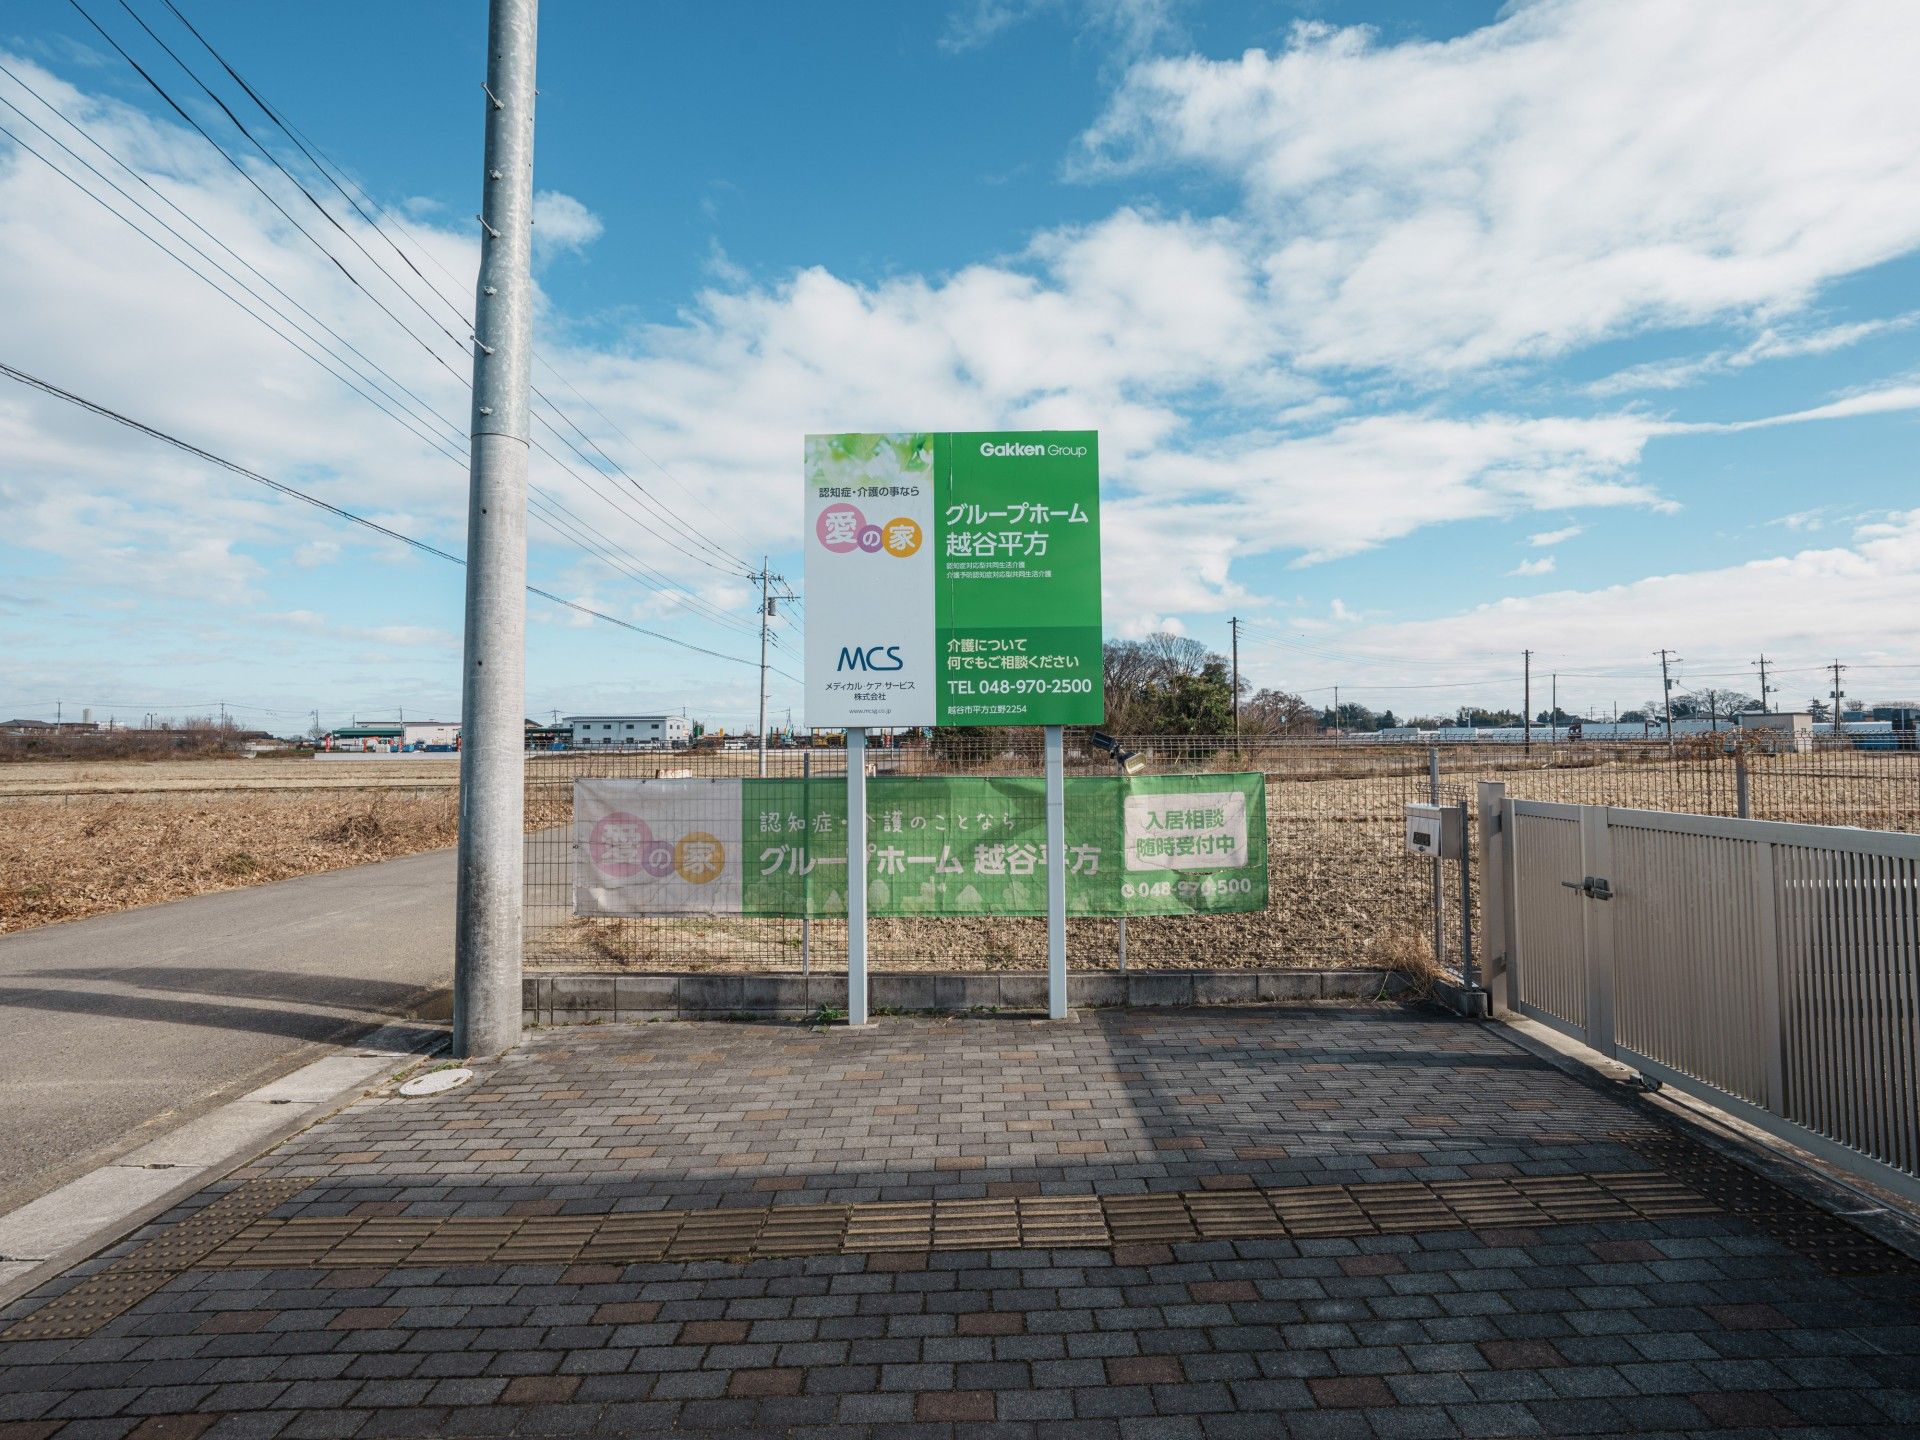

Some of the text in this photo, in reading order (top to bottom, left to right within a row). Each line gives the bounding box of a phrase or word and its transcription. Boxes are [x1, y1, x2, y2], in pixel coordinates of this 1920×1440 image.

[980, 442, 1088, 457] Gakken Group
[818, 486, 920, 498] 認知症・介護の事なら
[945, 501, 1089, 526] グループホーム
[825, 511, 916, 551] 愛の家
[946, 531, 1049, 557] 越谷平方
[947, 638, 1028, 653] 介護について
[836, 646, 904, 672] MCS
[947, 655, 1080, 671] 何でもご相談ください
[853, 692, 887, 701] 株式会社
[947, 679, 1092, 695] TEL 048-970-2500
[947, 704, 1028, 715] 越谷市平方立野2254
[1145, 808, 1225, 830] 入居相談
[601, 822, 717, 875] 愛の家
[1136, 834, 1235, 857] 随時受付中
